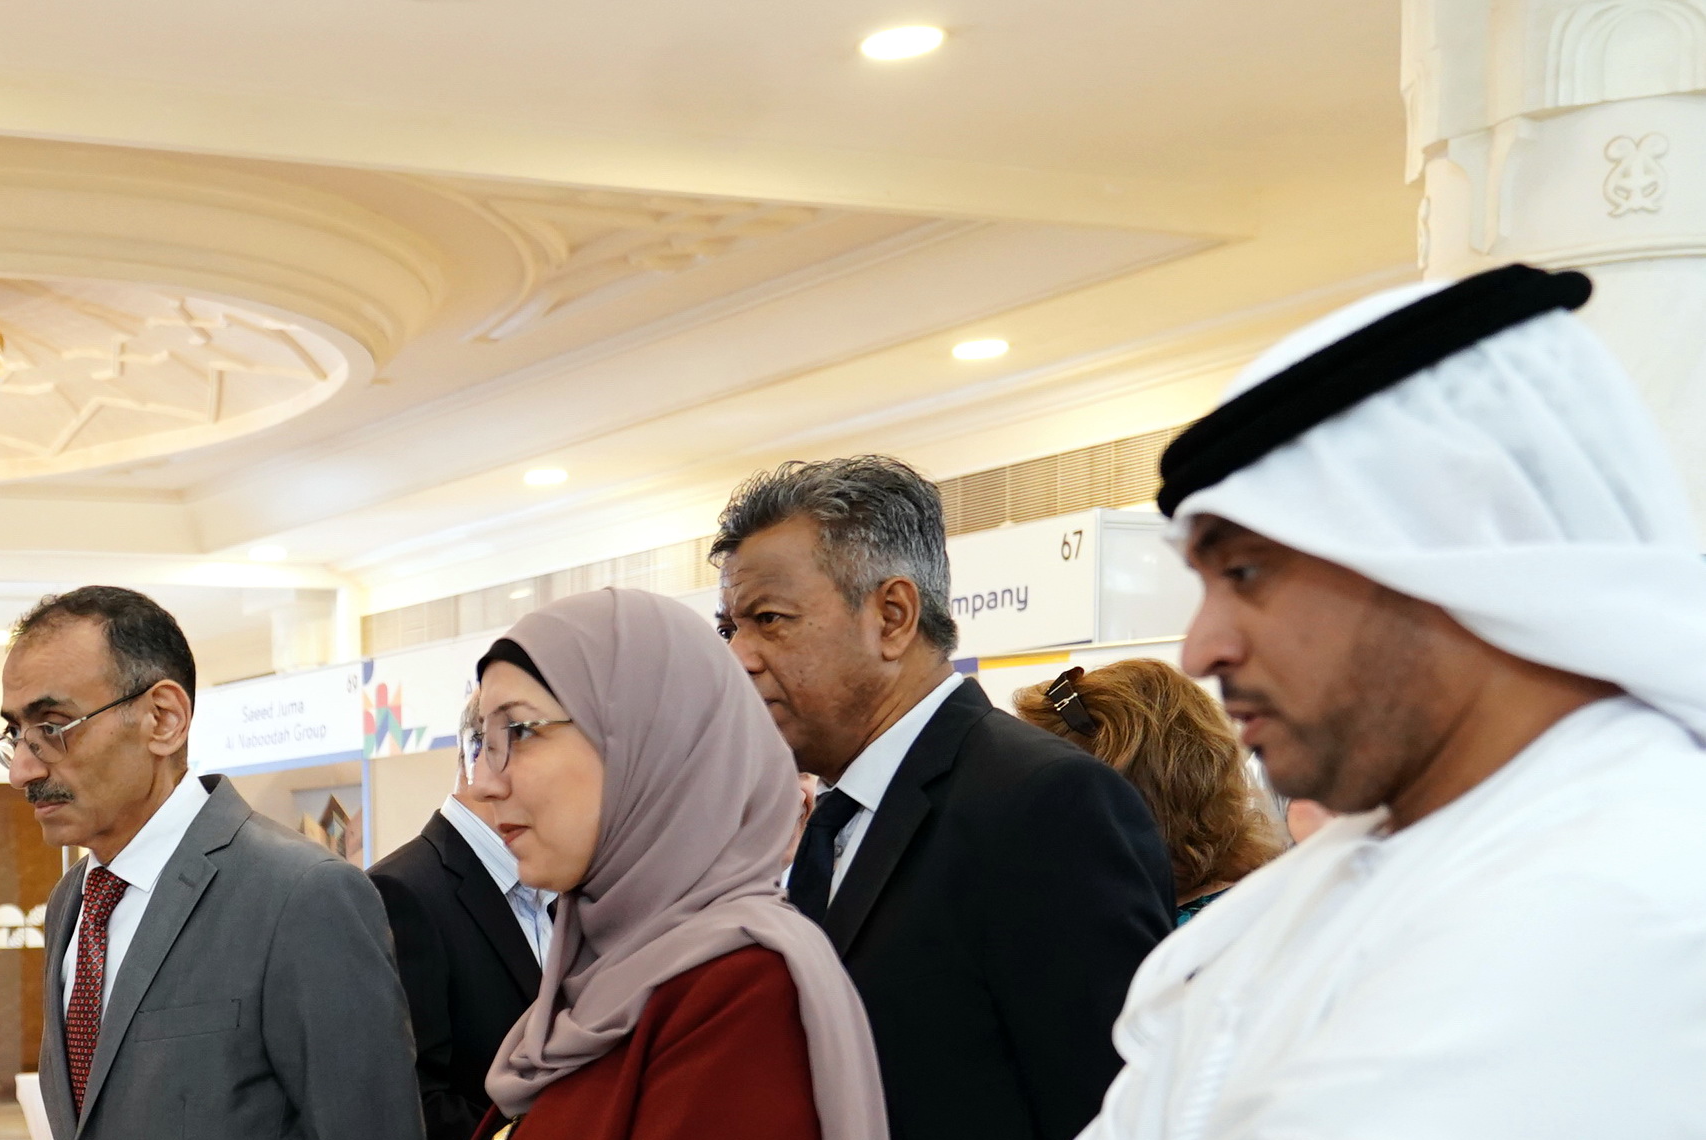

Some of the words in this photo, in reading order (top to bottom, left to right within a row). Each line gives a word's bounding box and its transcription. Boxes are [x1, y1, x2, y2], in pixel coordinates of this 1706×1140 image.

[1060, 529, 1084, 562] 67
[950, 585, 1029, 620] mpany
[241, 700, 274, 724] Saeed
[277, 699, 305, 718] Juma
[293, 722, 327, 743] Group
